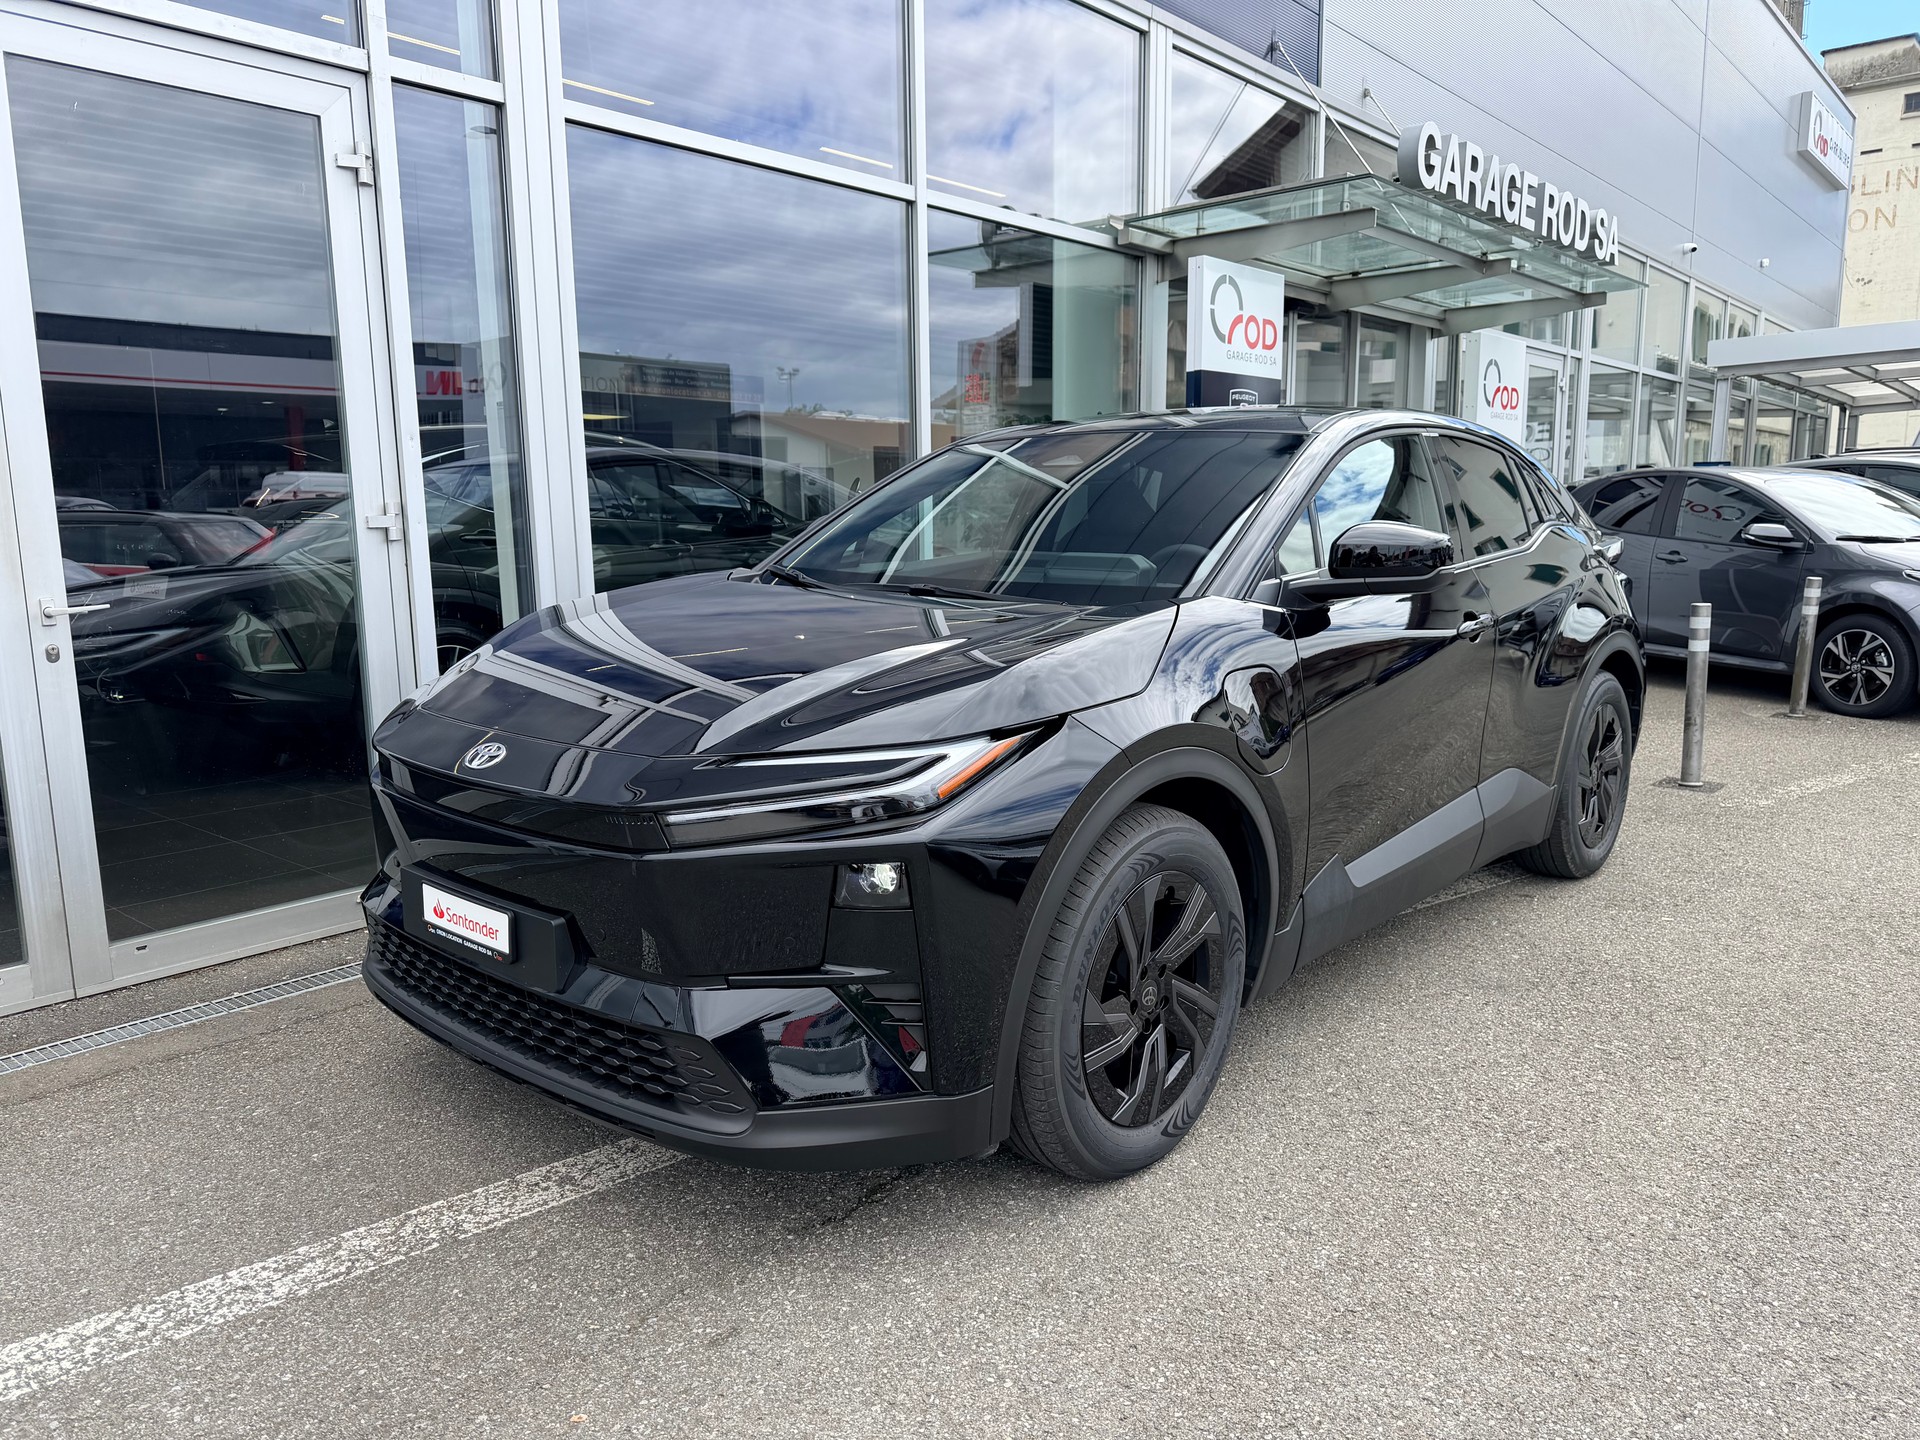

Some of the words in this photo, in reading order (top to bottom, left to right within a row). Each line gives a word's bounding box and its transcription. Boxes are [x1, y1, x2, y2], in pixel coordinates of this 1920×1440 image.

[1416, 120, 1538, 232] GARAGE
[1541, 182, 1591, 252] ROD
[1594, 208, 1619, 266] SA
[1226, 350, 1253, 363] GARAGE
[1254, 353, 1268, 366] ROD
[1269, 356, 1277, 367] SA
[1231, 394, 1257, 402] PEUGEOT
[446, 907, 500, 942] Santander
[445, 932, 463, 945] LOCATION
[463, 940, 479, 951] GARAGE
